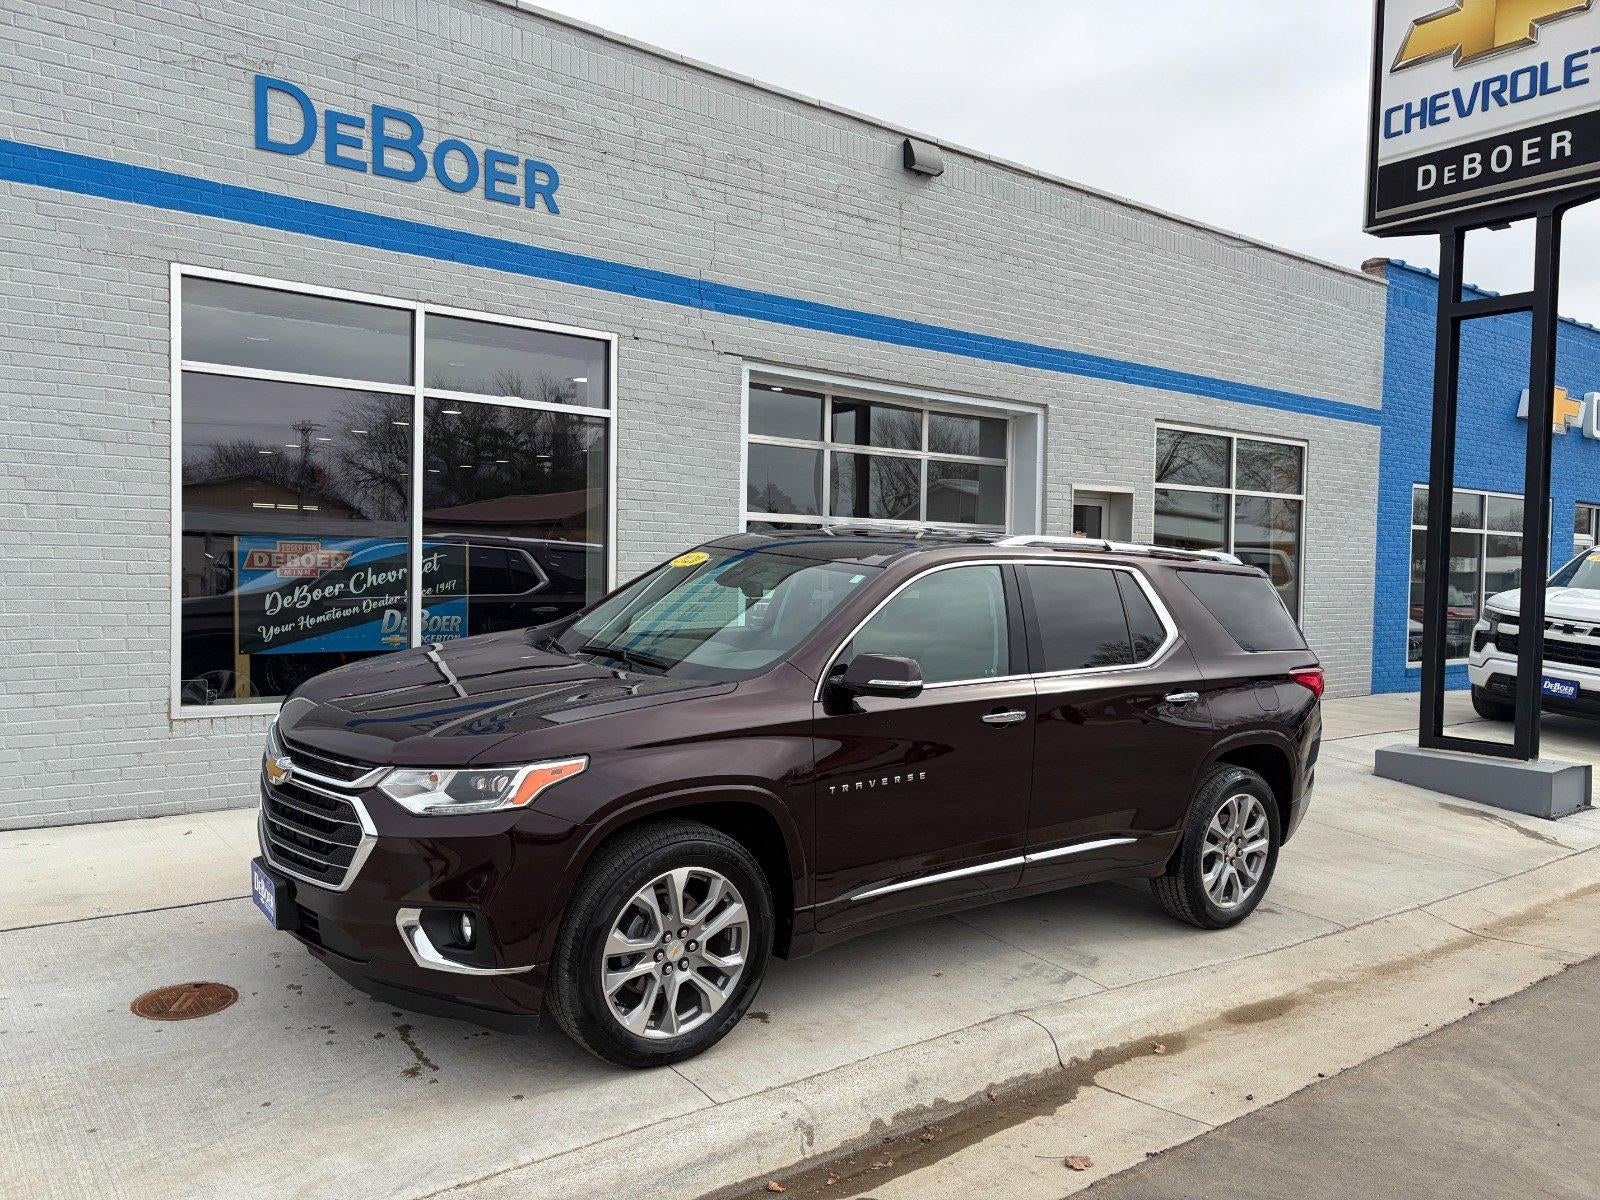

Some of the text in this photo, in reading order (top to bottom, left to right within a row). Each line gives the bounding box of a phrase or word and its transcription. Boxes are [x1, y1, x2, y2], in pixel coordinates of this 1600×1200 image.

[1384, 46, 1600, 140] CHEVROLE
[253, 552, 344, 569] DEBOER
[281, 543, 318, 552] EDGERTON
[264, 552, 448, 616] DeBoer Chevret
[258, 623, 295, 643] Your
[298, 607, 360, 631] Hometown
[362, 594, 401, 613] Dealer
[436, 579, 457, 594] 1947
[829, 771, 926, 795] TRAVERSE
